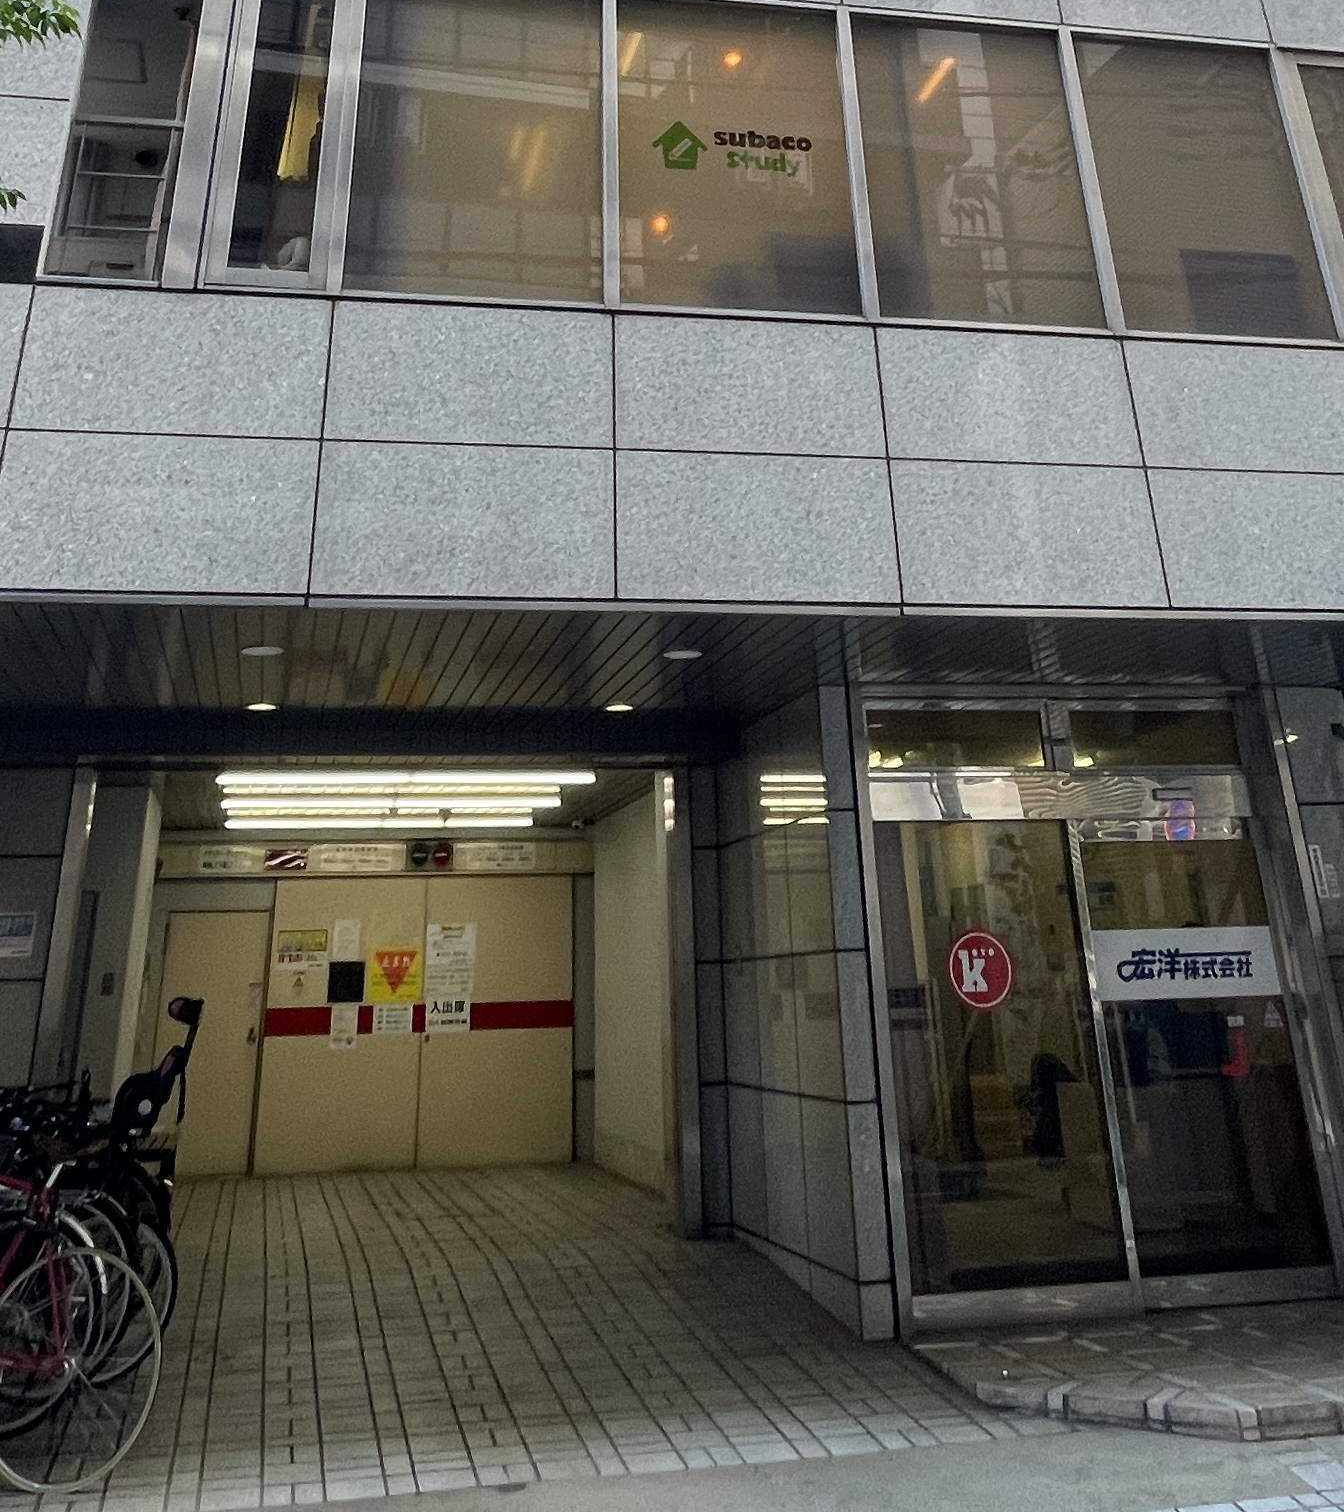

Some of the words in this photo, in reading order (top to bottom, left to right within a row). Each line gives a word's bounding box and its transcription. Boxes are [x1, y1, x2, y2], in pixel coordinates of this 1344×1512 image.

[713, 130, 813, 152] subaco
[725, 151, 801, 177] study
[1116, 948, 1254, 982] 宏洋株式会社
